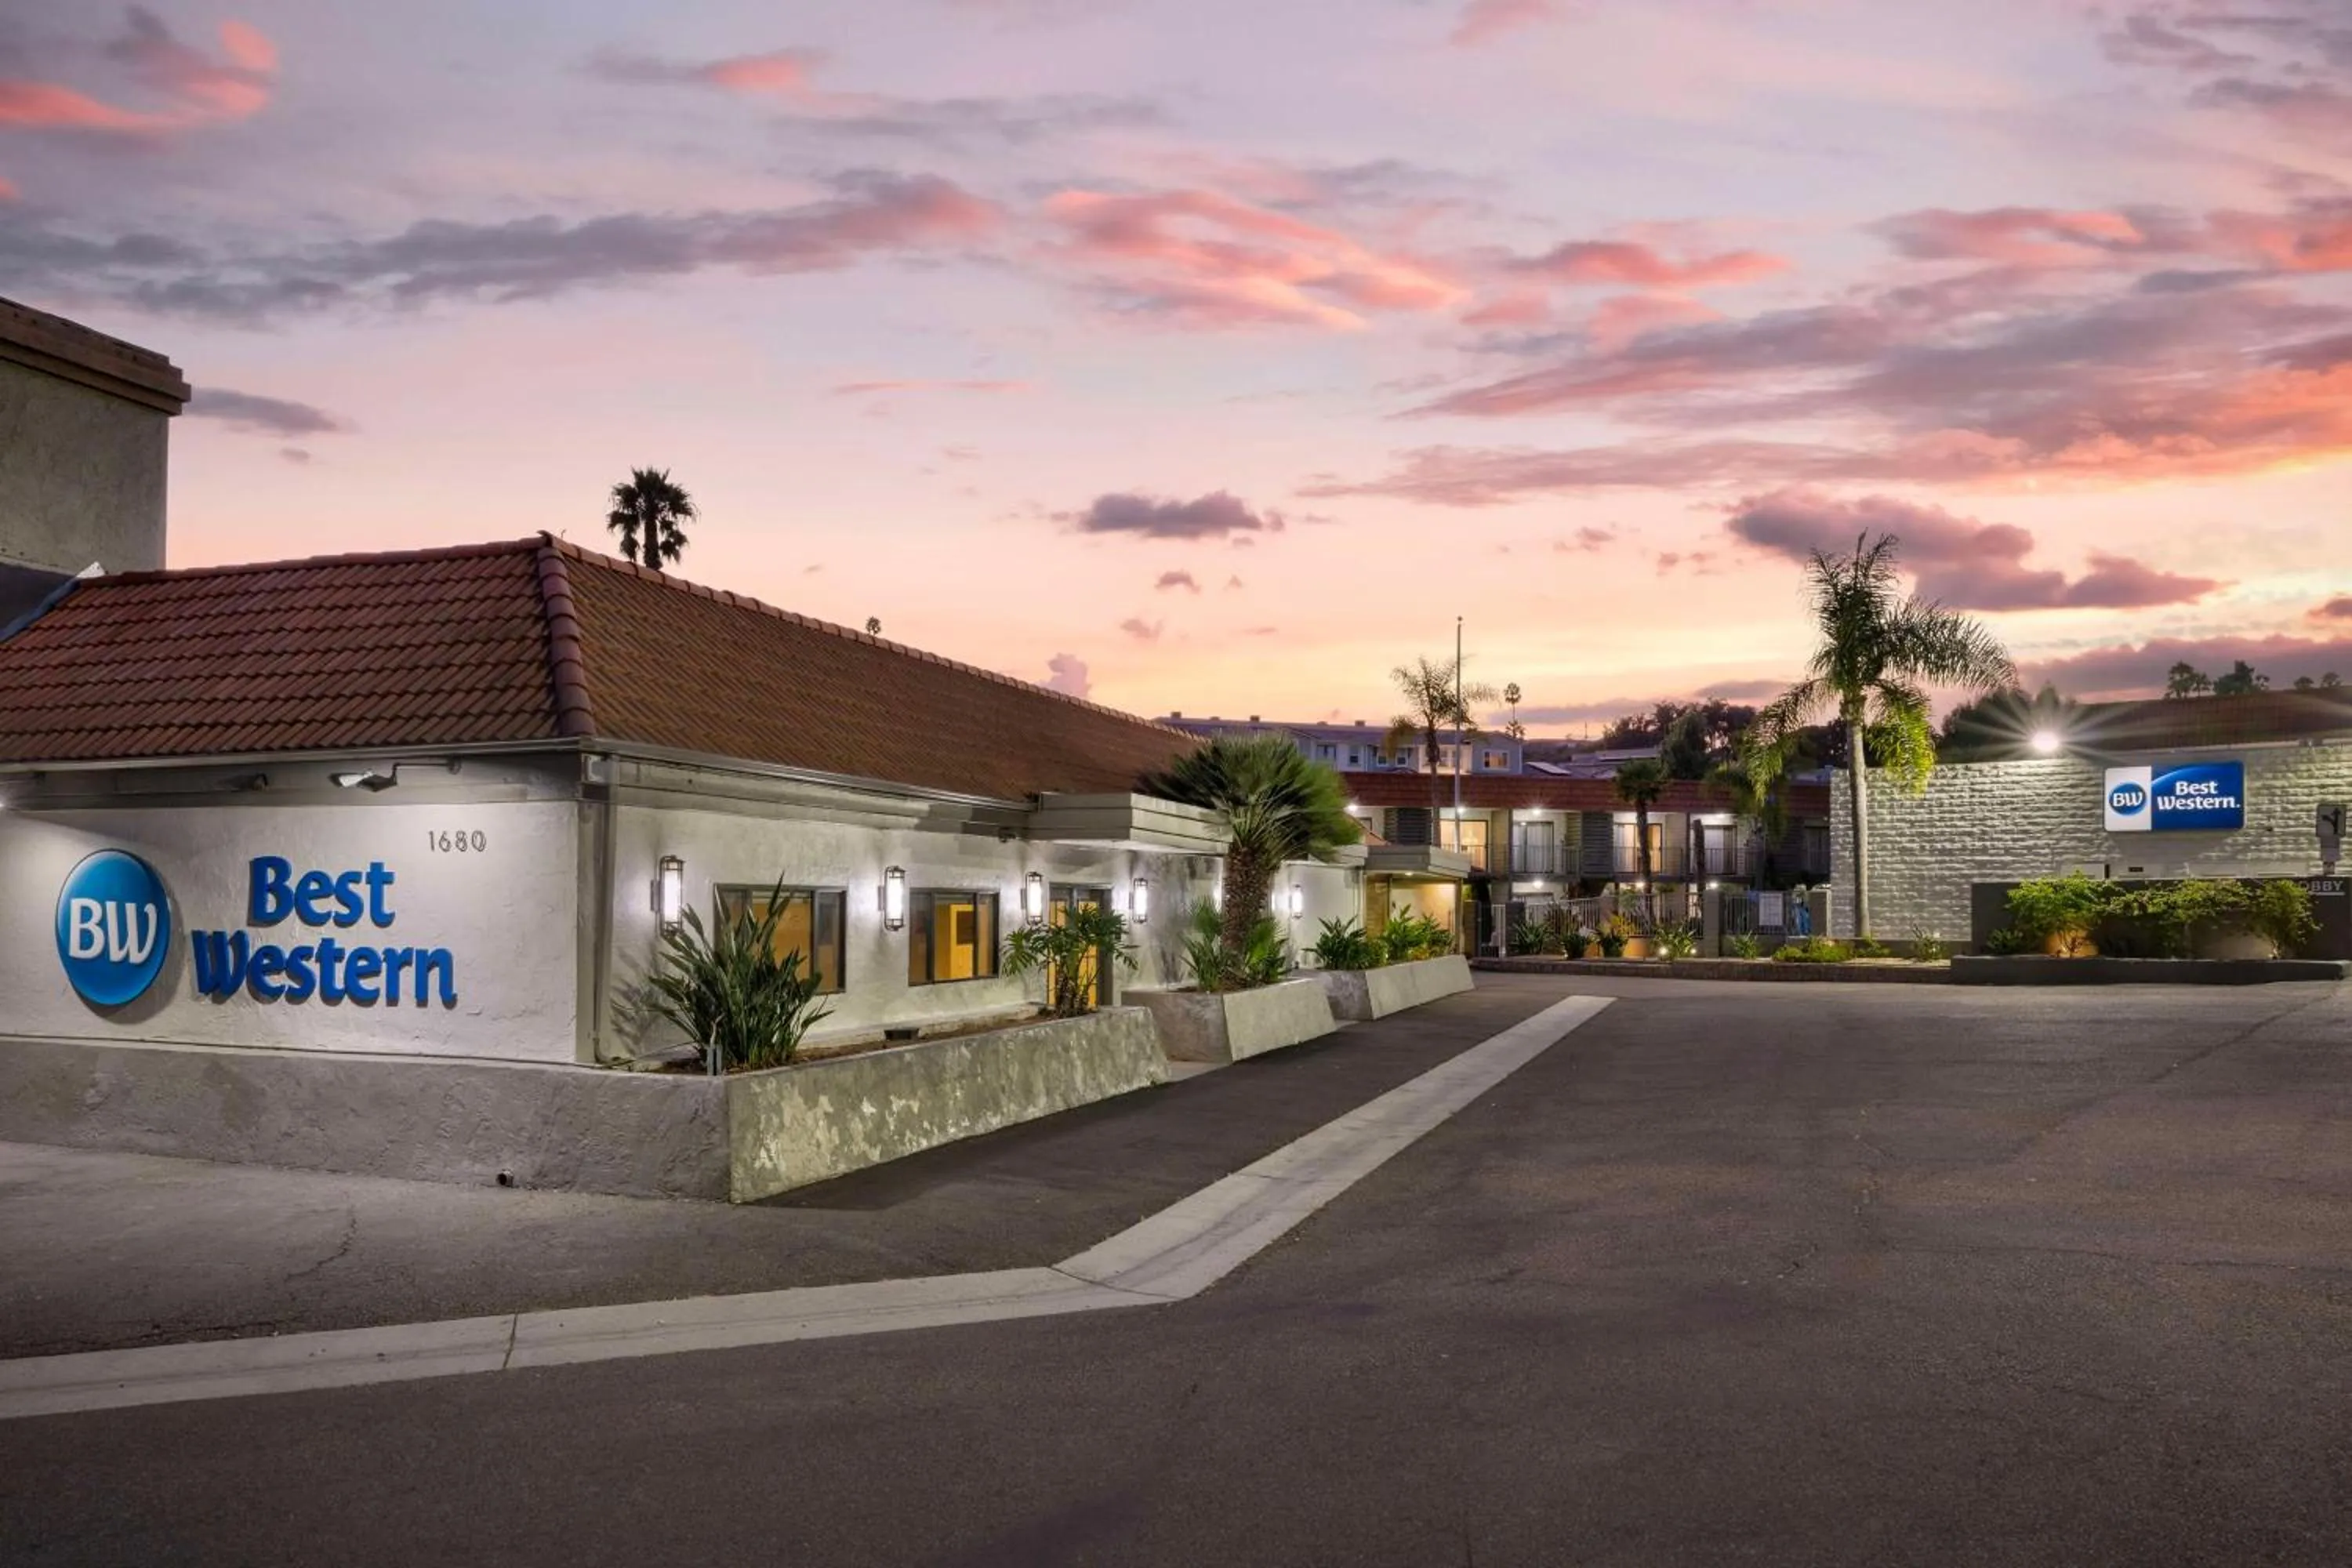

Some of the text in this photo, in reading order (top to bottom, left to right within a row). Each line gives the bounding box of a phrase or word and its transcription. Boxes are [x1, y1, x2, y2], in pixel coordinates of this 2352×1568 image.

[2113, 792, 2143, 807] BW
[2175, 781, 2218, 796] Best
[428, 830, 487, 852] 1680
[249, 855, 395, 927] Best
[2296, 880, 2343, 891] OBBY
[68, 898, 157, 964] BW
[191, 929, 457, 1008] Western
